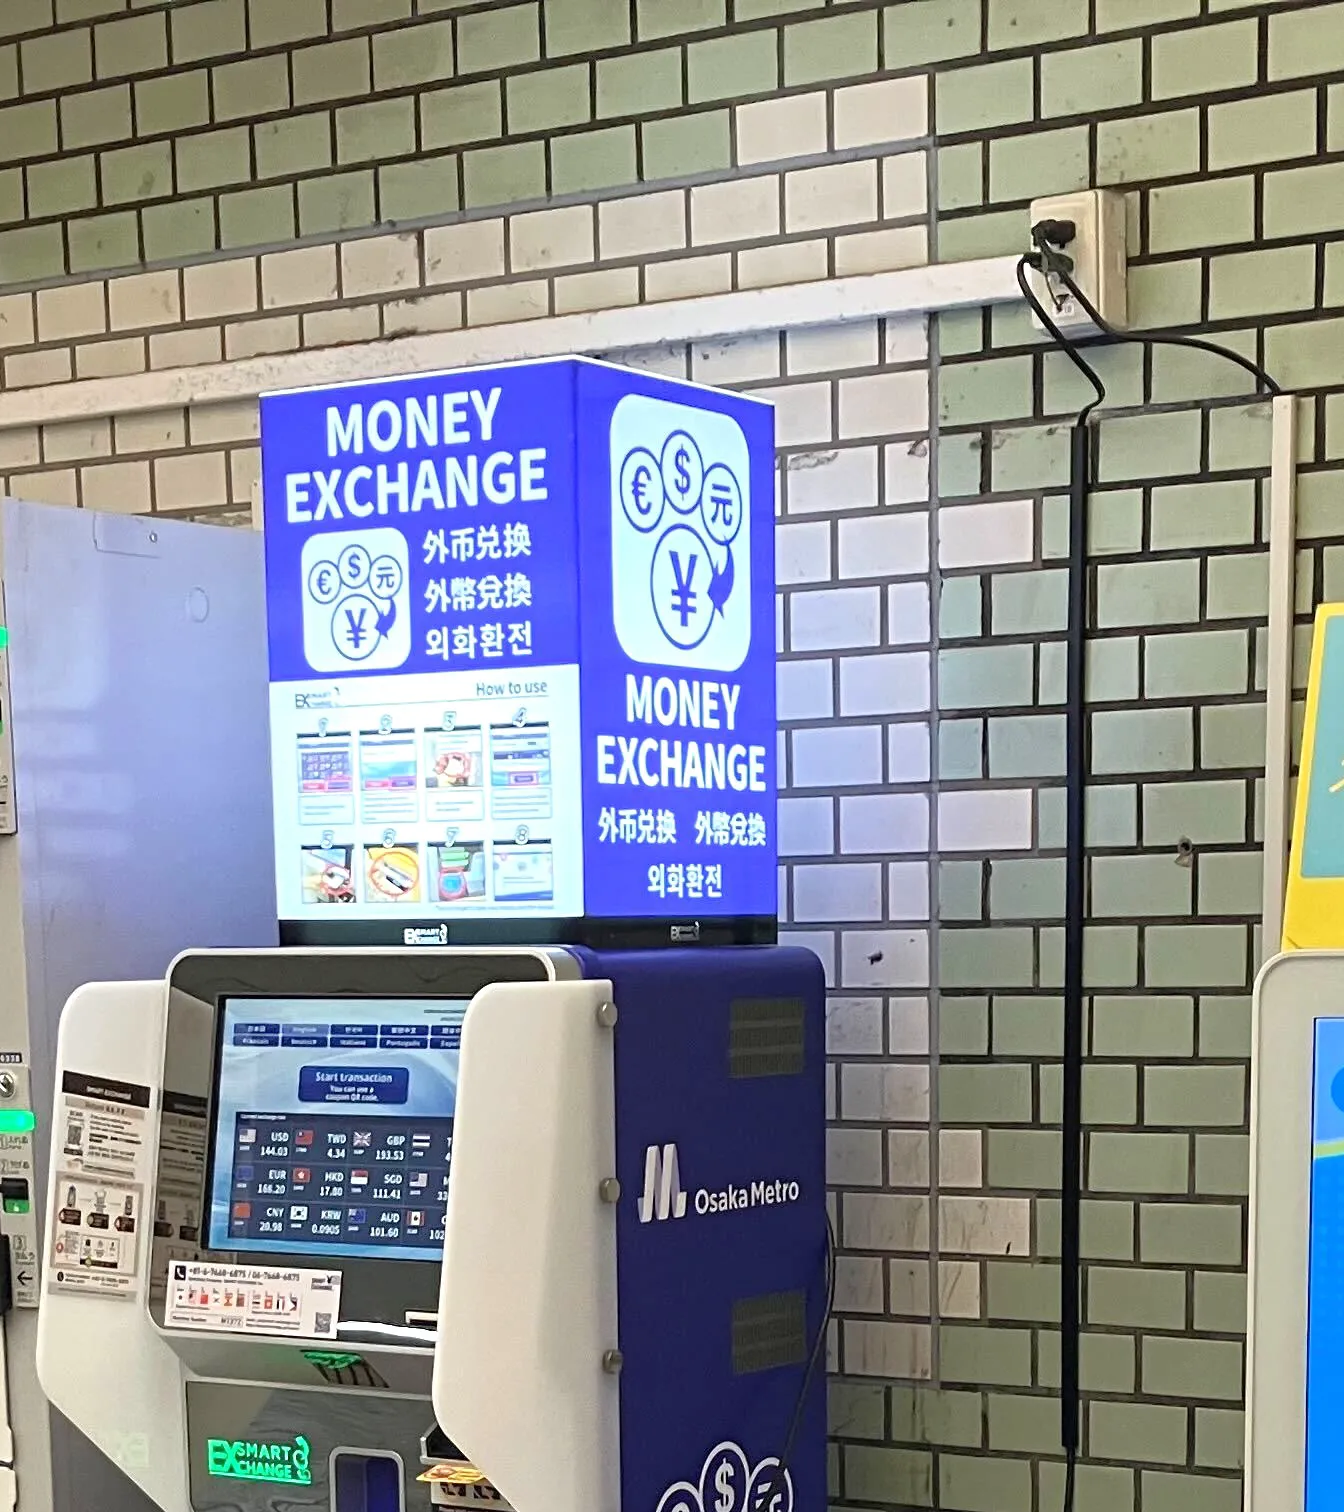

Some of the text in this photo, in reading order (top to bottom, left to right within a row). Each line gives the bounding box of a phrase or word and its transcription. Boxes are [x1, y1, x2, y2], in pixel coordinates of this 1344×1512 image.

[326, 387, 502, 457] MONEY
[286, 449, 548, 523] EXCHANGE
[423, 523, 532, 564] 外币兑换
[425, 622, 533, 661] 외화환전
[476, 681, 547, 696] How to use
[626, 674, 740, 730] MONEY
[597, 736, 766, 792] EXCHANGE
[515, 824, 529, 844] 8
[598, 807, 676, 845] 外币兑换
[647, 865, 722, 898] 외화환전
[316, 1072, 392, 1083] Start transaction
[271, 1132, 405, 1145] USD TWD GBP
[268, 1170, 402, 1184] EUR HKD SGD
[373, 1188, 401, 1199] 111.41
[695, 1180, 799, 1215] Osaka Metro
[267, 1208, 399, 1223] CNY KRW AUD
[237, 1442, 291, 1462] SMART
[239, 1459, 292, 1480] CHANGE
